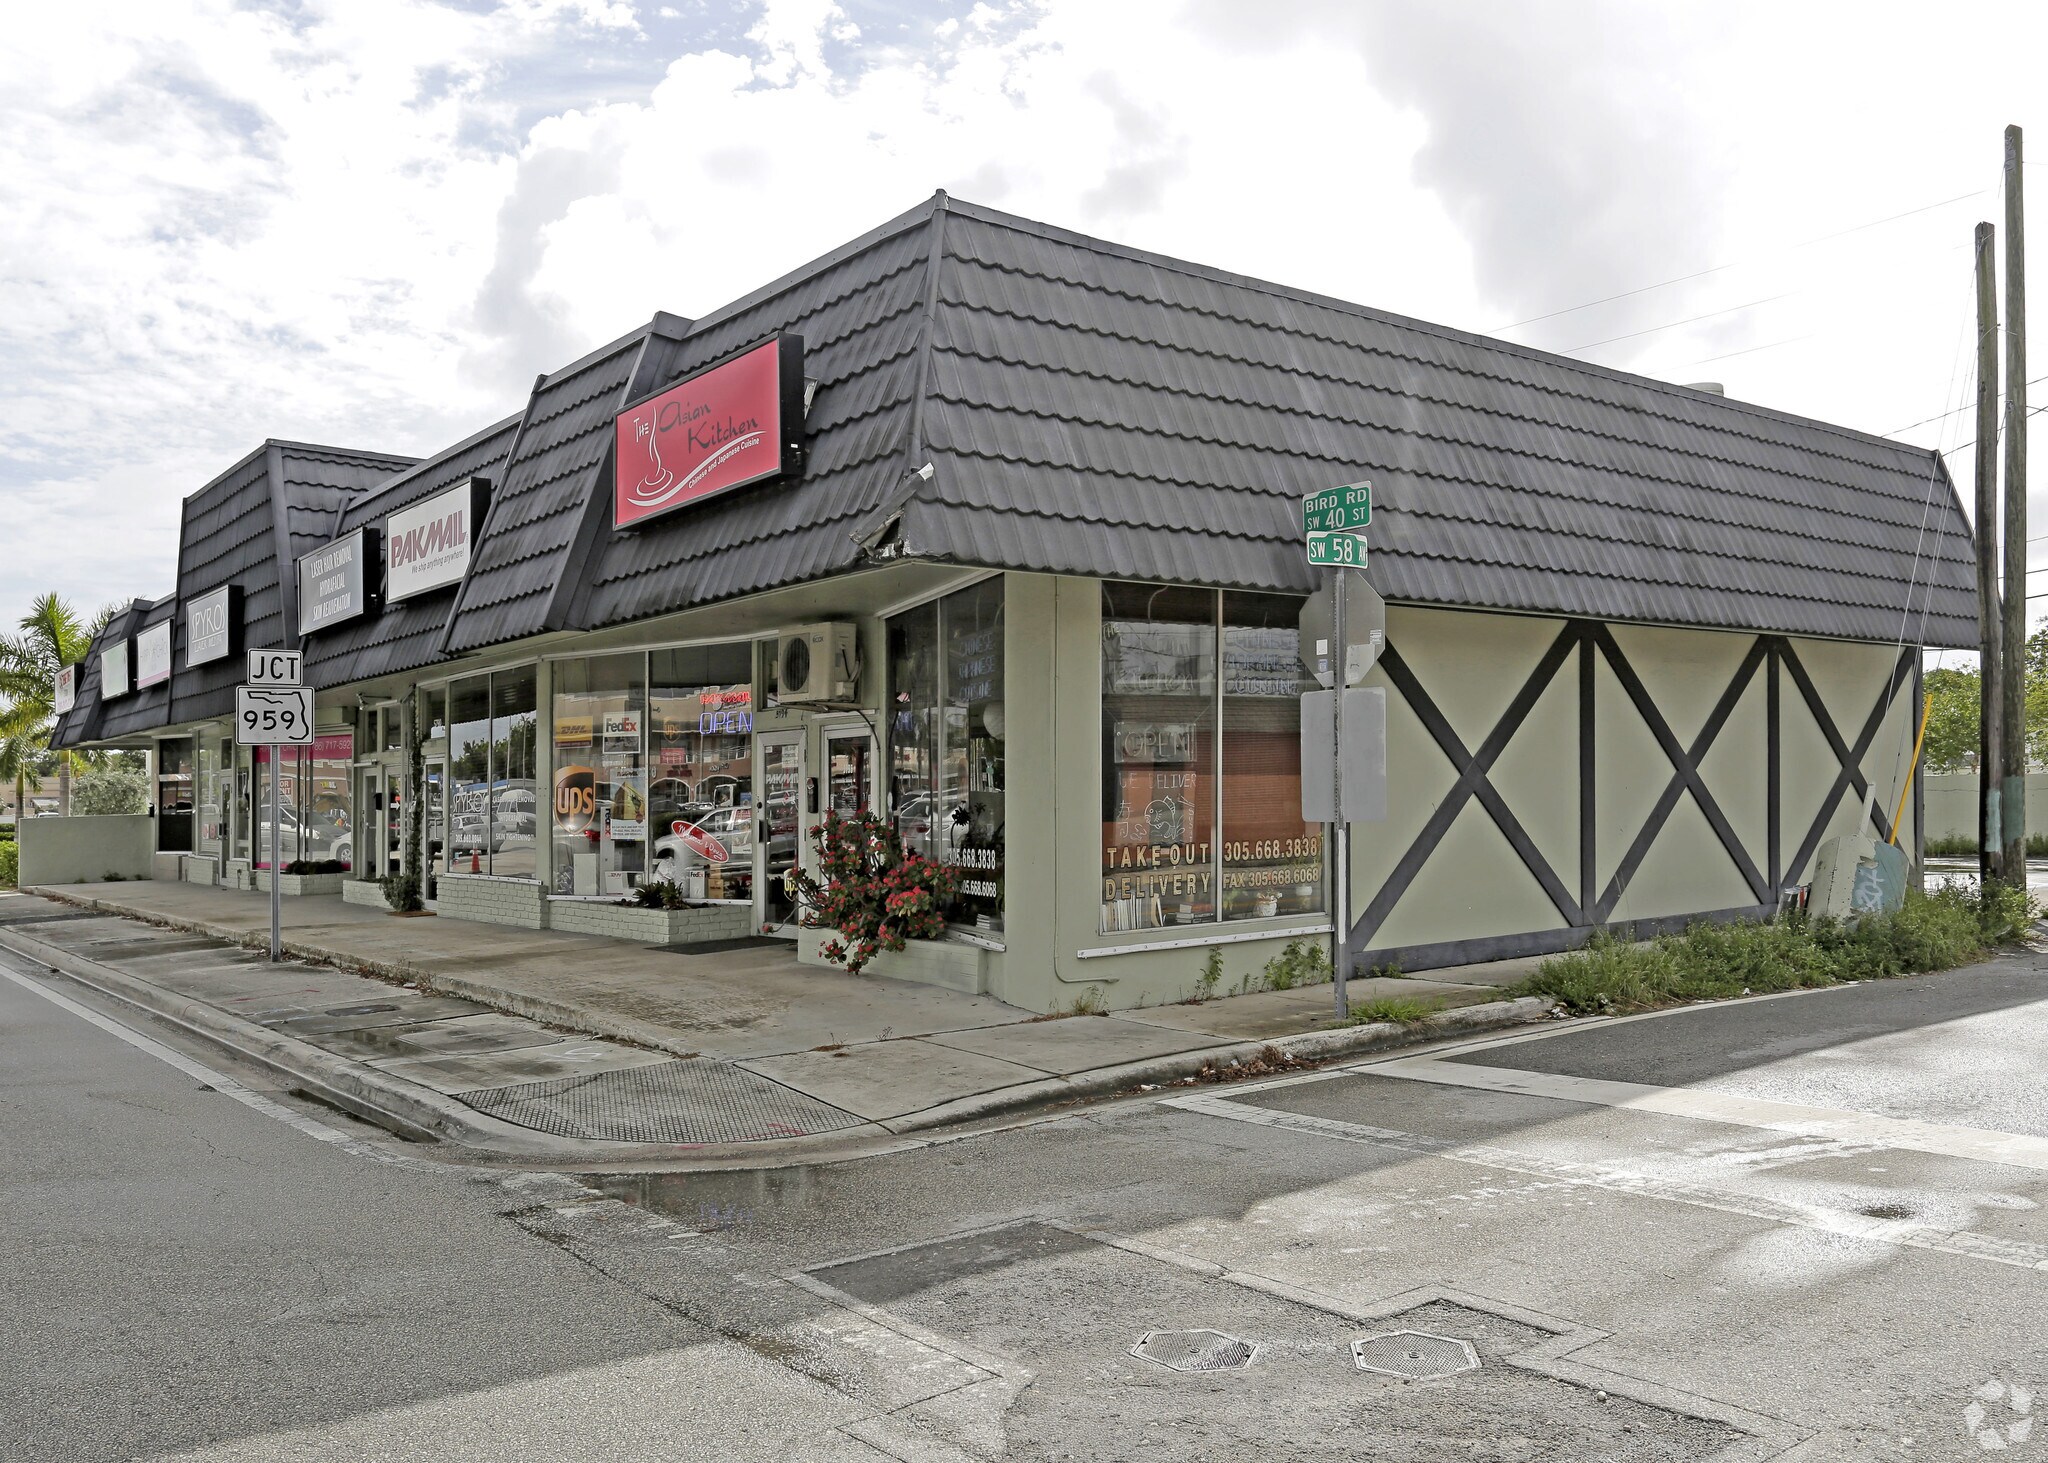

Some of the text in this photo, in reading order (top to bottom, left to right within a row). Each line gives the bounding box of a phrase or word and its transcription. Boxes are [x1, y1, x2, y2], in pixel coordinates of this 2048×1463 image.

[658, 401, 711, 432] Asian
[688, 416, 758, 454] Kitchen
[688, 437, 760, 489] Chinese and Japanese Cuisine
[1306, 489, 1367, 514] BIRD RD
[1307, 506, 1366, 530] SW 40 ST
[310, 545, 353, 579] LASER HAIR REMOVAL
[1310, 538, 1367, 562] SW 58 AV
[418, 561, 427, 573] ship
[427, 555, 443, 570] anything
[319, 572, 345, 597] HYDRAFACIAL
[191, 602, 226, 640] SPYROS
[312, 604, 323, 622] SKIN
[252, 656, 299, 679] JCT
[243, 710, 295, 731] 959
[561, 725, 587, 735] DHL
[606, 717, 637, 732] FedEx
[699, 711, 753, 735] OPEN
[557, 786, 594, 823] ups
[947, 847, 996, 870] 305.668.3838
[1107, 843, 1209, 869] TAKE OUT
[1224, 836, 1318, 862] 305.668.3838
[960, 879, 997, 897] 05.668.6068
[1105, 872, 1211, 900] DELIVERY
[1223, 867, 1319, 889] FAX 305.668.6068
